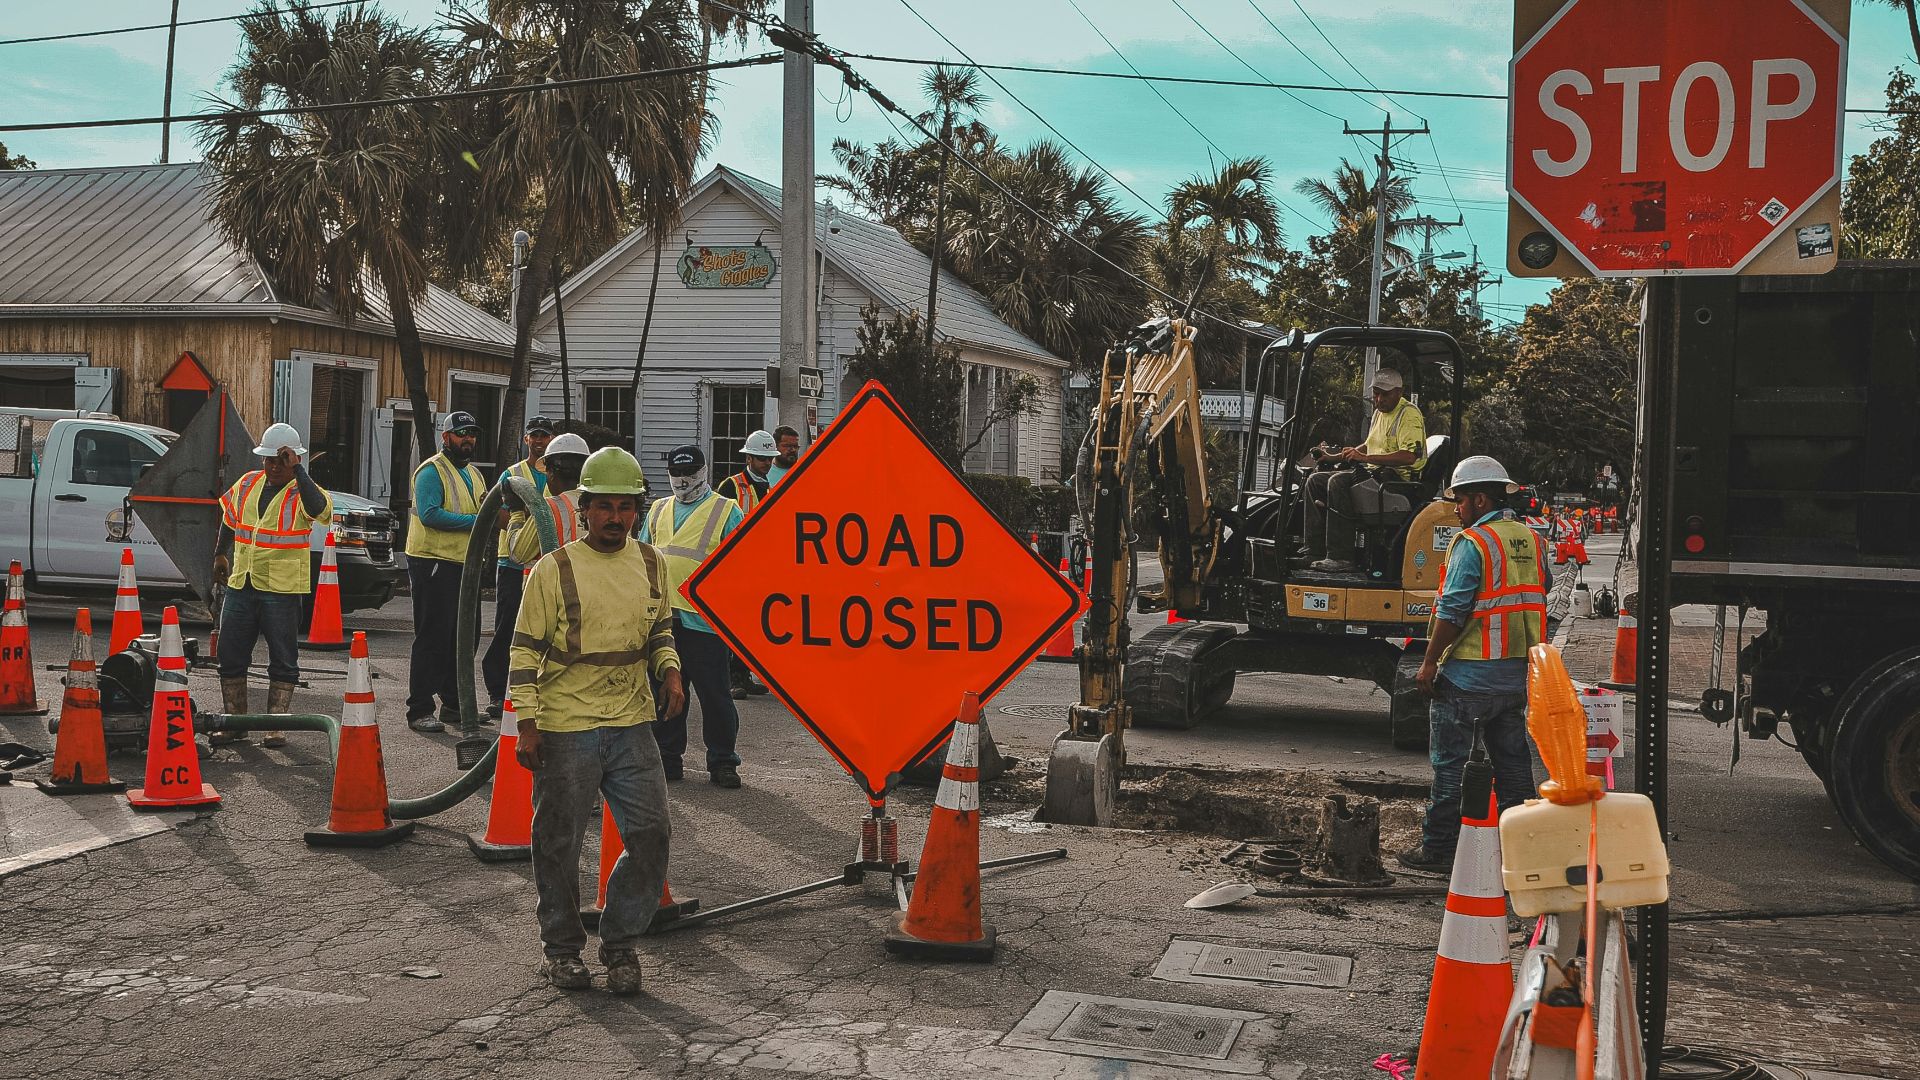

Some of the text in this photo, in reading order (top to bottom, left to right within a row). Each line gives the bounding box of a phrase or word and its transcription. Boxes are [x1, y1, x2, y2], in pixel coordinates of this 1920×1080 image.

[1532, 58, 1817, 178] STOP
[703, 249, 746, 272] Shots
[720, 264, 769, 287] Giggles
[794, 511, 965, 568] ROAD
[760, 593, 1003, 652] CLOSED
[1313, 599, 1326, 609] 36
[166, 696, 185, 751] FKAA
[160, 765, 189, 786] CC
